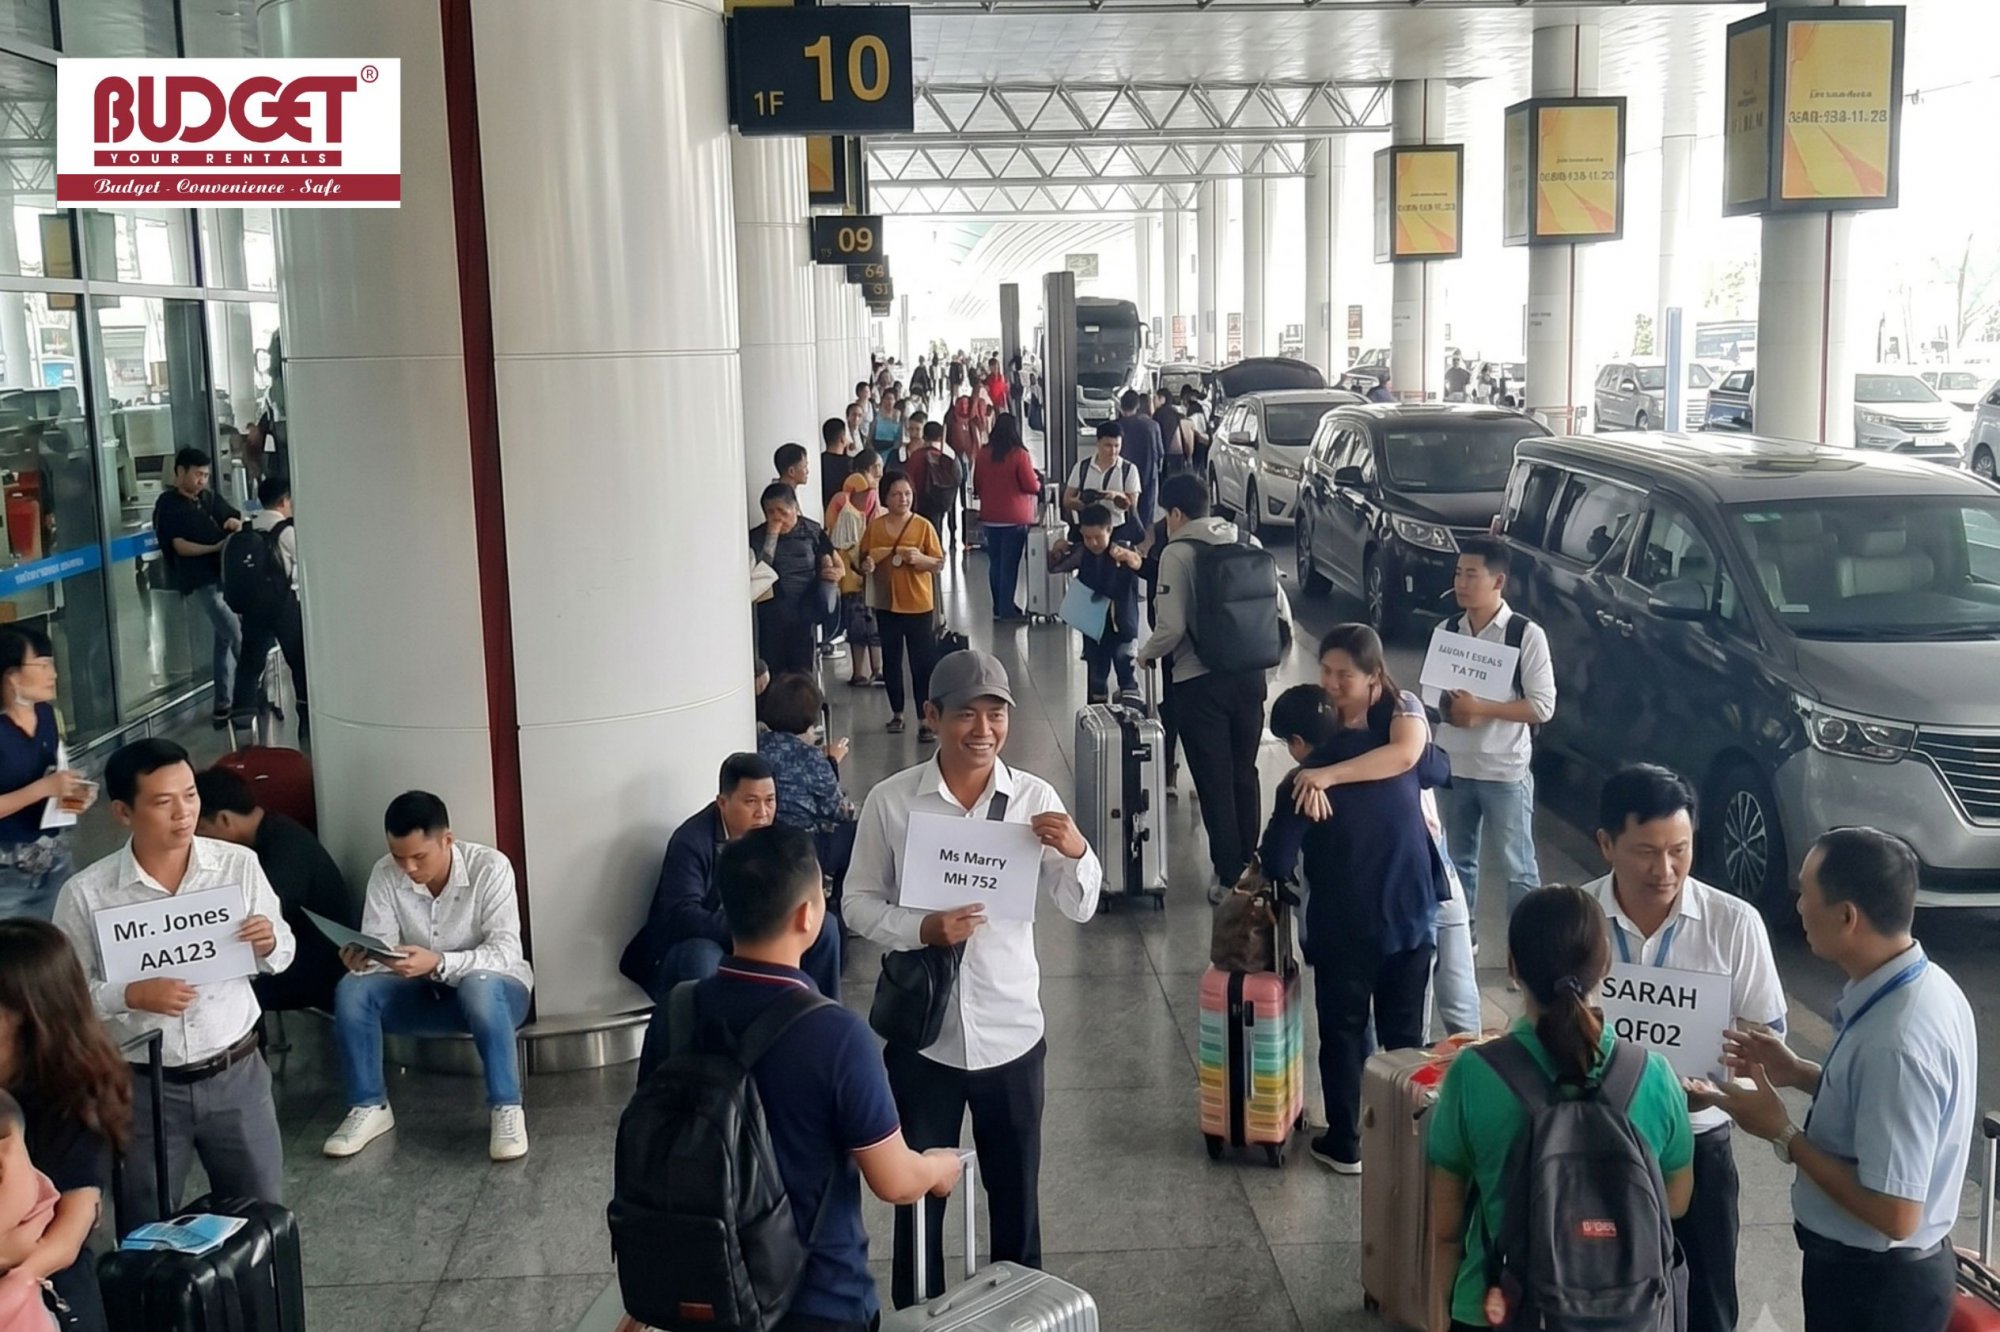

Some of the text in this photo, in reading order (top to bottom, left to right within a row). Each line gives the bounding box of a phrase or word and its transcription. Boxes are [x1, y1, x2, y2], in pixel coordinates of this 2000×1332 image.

[804, 34, 890, 102] 10
[754, 90, 785, 116] 1F
[838, 227, 873, 252] 09
[939, 848, 1006, 870] Ms Marry
[944, 872, 998, 890] MH 752
[113, 907, 231, 942] Mr. Jones
[140, 940, 217, 971] AA123
[1601, 977, 1697, 1010] SARAH
[1614, 1017, 1682, 1047] QF02
